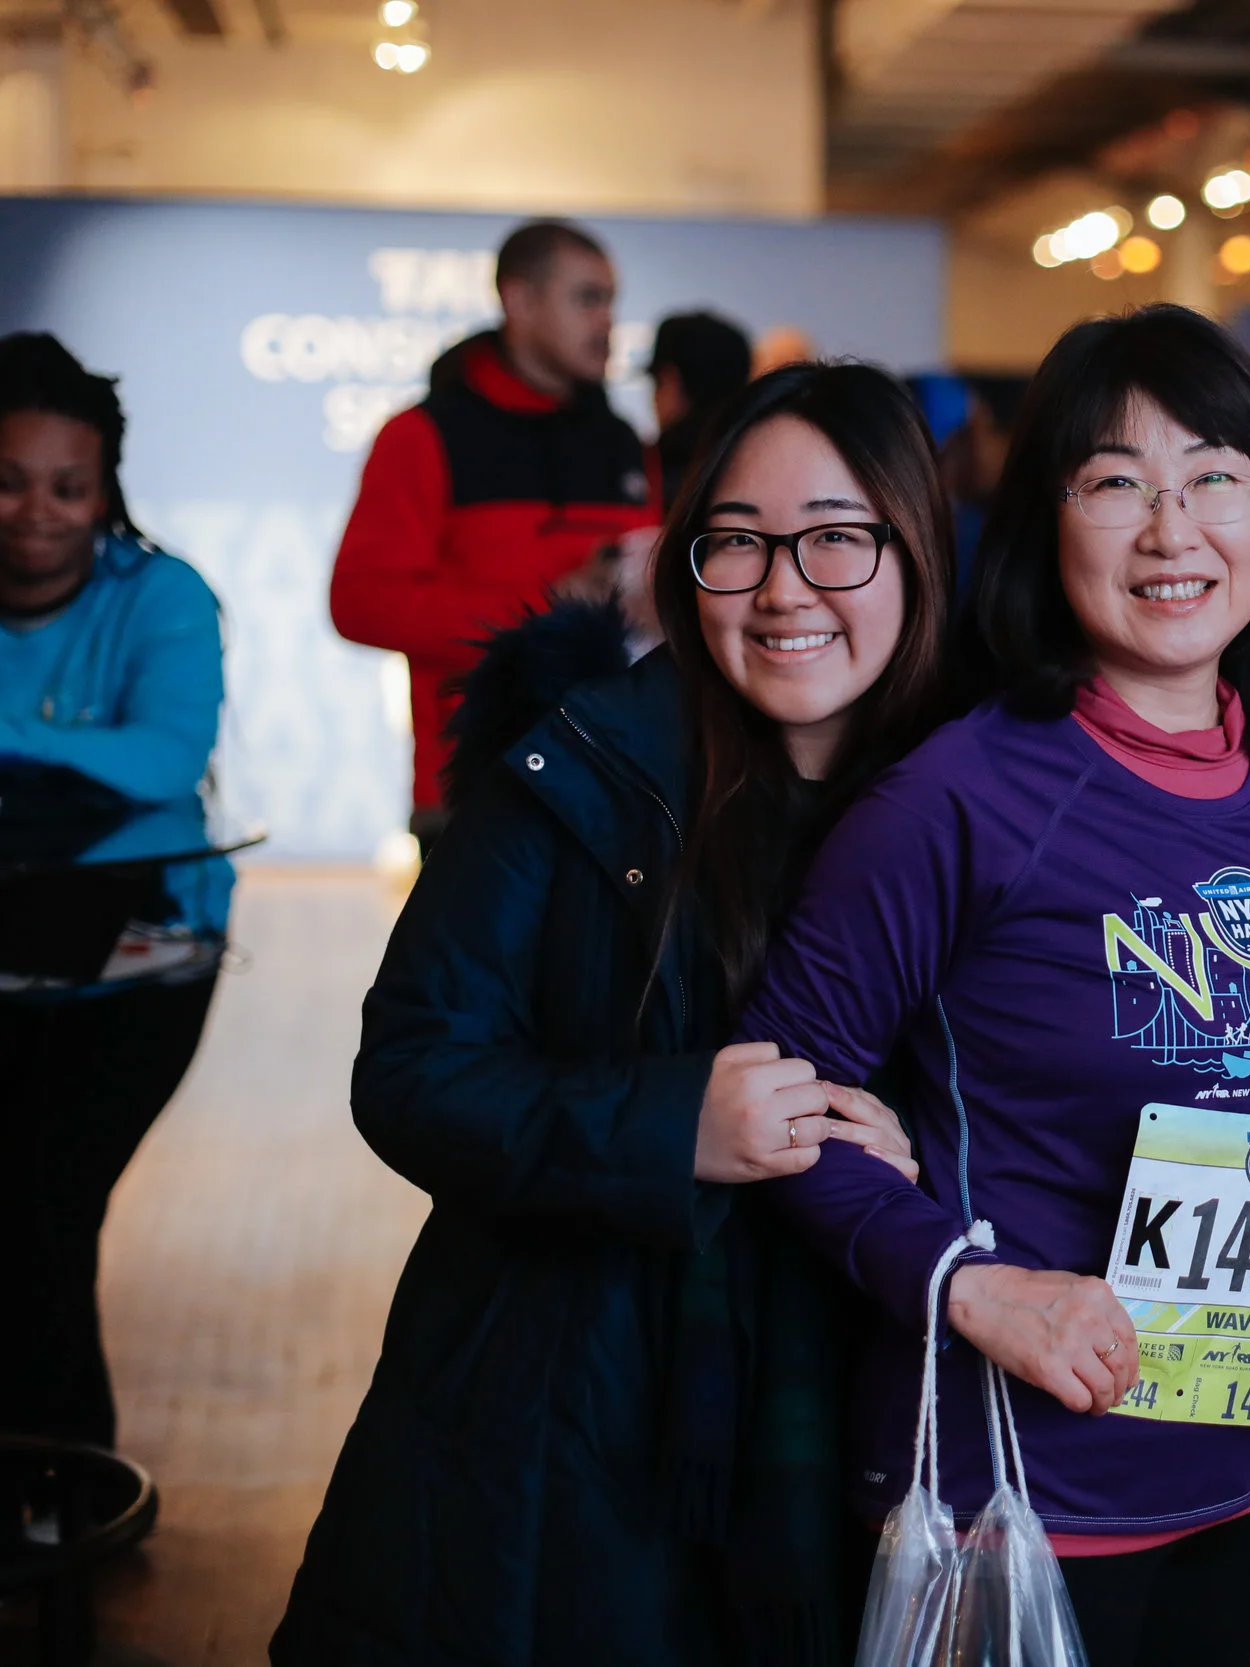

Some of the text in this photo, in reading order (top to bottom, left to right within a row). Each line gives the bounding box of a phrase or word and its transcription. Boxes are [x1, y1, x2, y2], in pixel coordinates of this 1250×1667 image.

[1232, 1088, 1249, 1097] NEW
[1139, 1342, 1165, 1351] ITED
[1190, 1377, 1202, 1418] Bag Check
